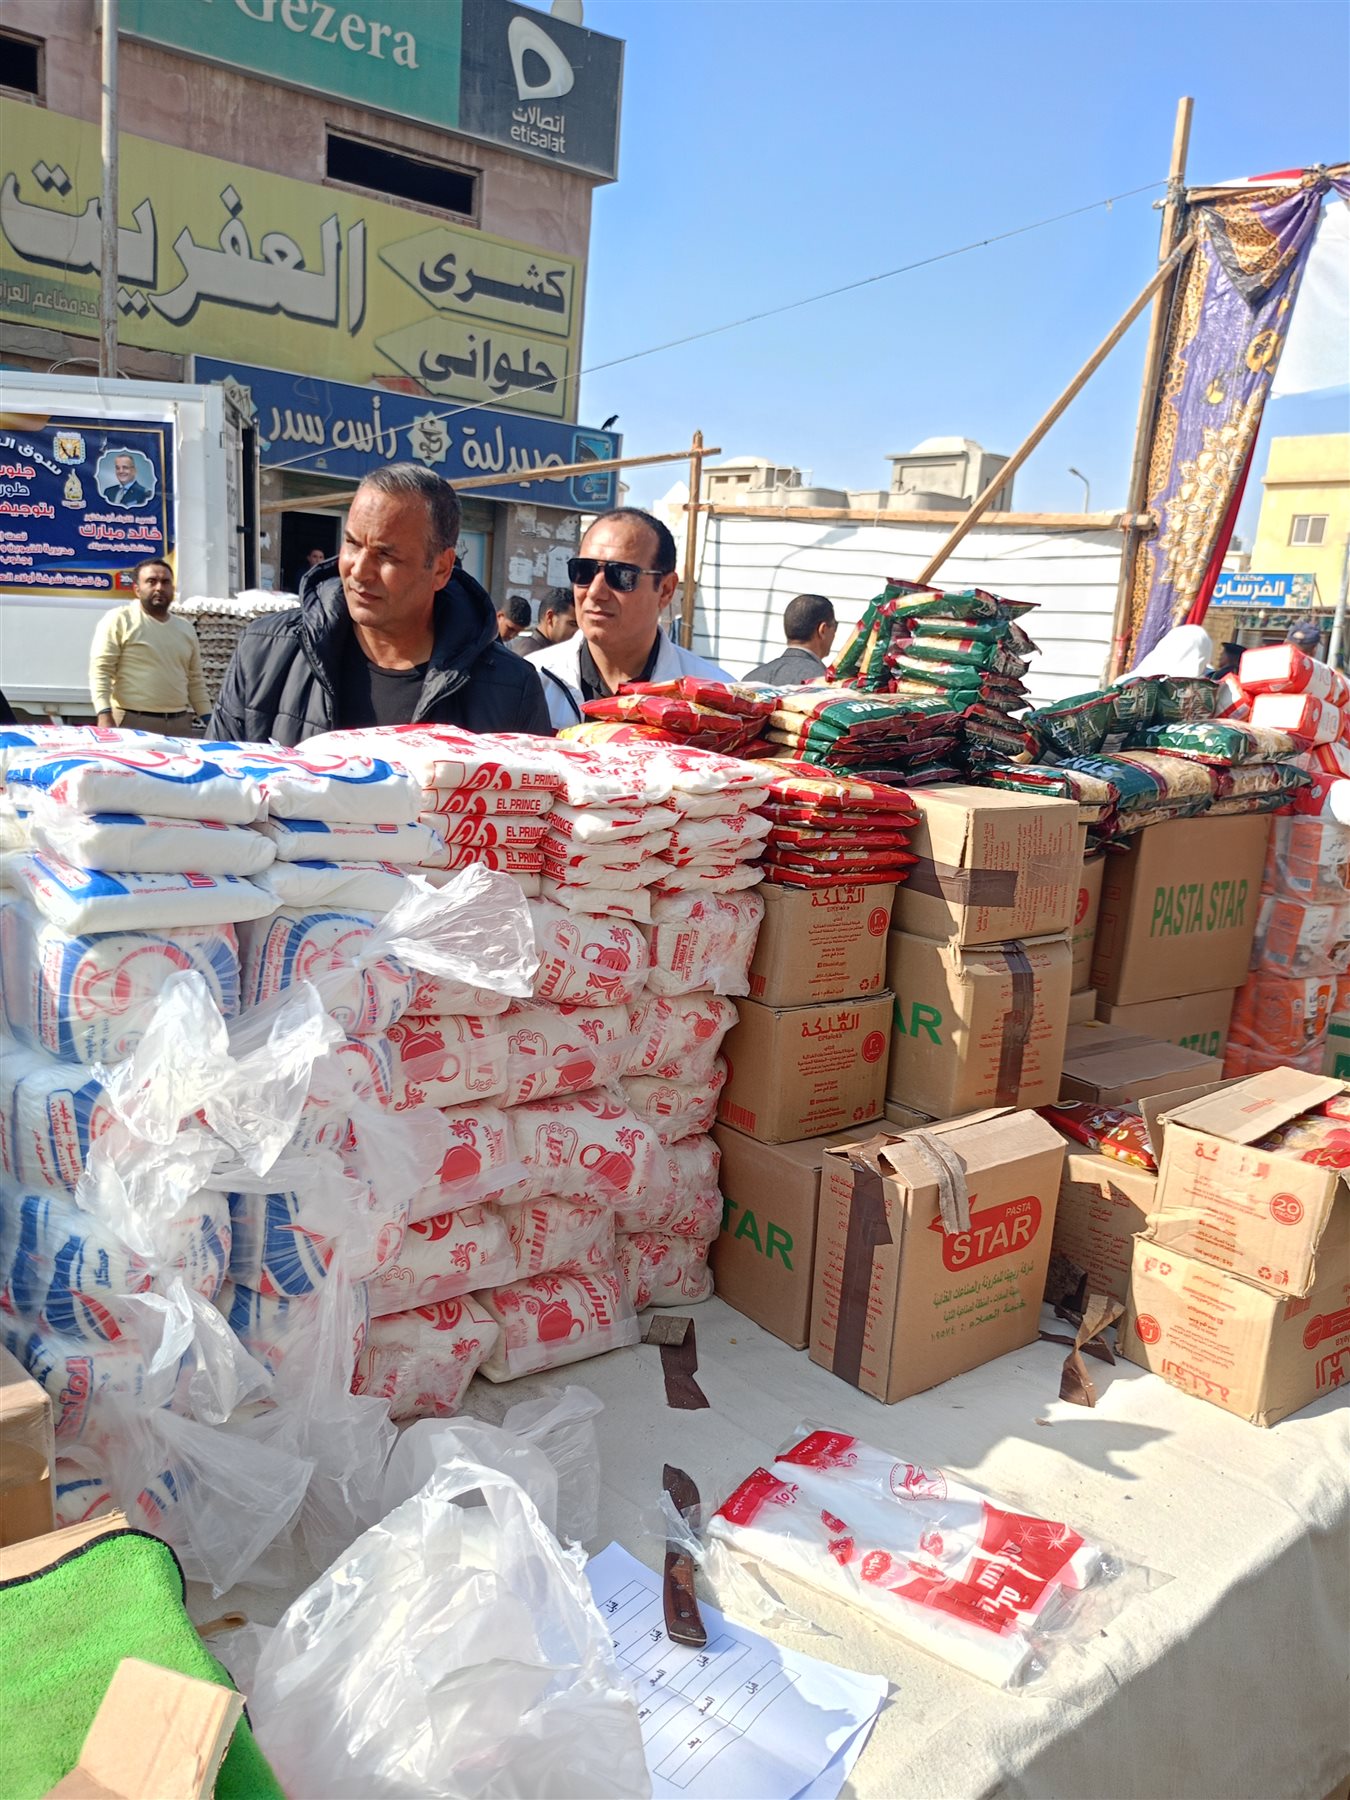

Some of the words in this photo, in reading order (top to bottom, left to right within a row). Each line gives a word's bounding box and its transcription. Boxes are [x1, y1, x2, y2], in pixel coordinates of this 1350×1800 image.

[512, 106, 565, 134] اتصالات
[511, 125, 566, 153] etisalat
[0, 160, 367, 338] العفريت
[419, 253, 566, 314] كشرى
[419, 334, 558, 395] حلوانى
[269, 406, 326, 446] سدر
[332, 396, 397, 459] رأس
[18, 444, 62, 475] سوق
[79, 524, 125, 540] مبارك
[127, 526, 163, 540] خالد
[1212, 580, 1285, 600] الفرسان
[522, 774, 531, 784] EL
[534, 774, 559, 785] PRINC
[1055, 756, 1121, 778] STAR
[497, 798, 507, 809] EL
[510, 799, 541, 810] PRINCE
[506, 826, 516, 837] EL
[519, 826, 547, 838] PRINCE
[506, 851, 516, 862] EL
[518, 852, 543, 863] PRINC
[1151, 884, 1204, 937] PASTA
[1206, 879, 1249, 931] STAR
[676, 944, 689, 972] PRINCE
[1005, 1201, 1031, 1217] PASTA
[1274, 1198, 1300, 1214] 20
[722, 1196, 794, 1271] TAR
[951, 1214, 1033, 1267] STAR
